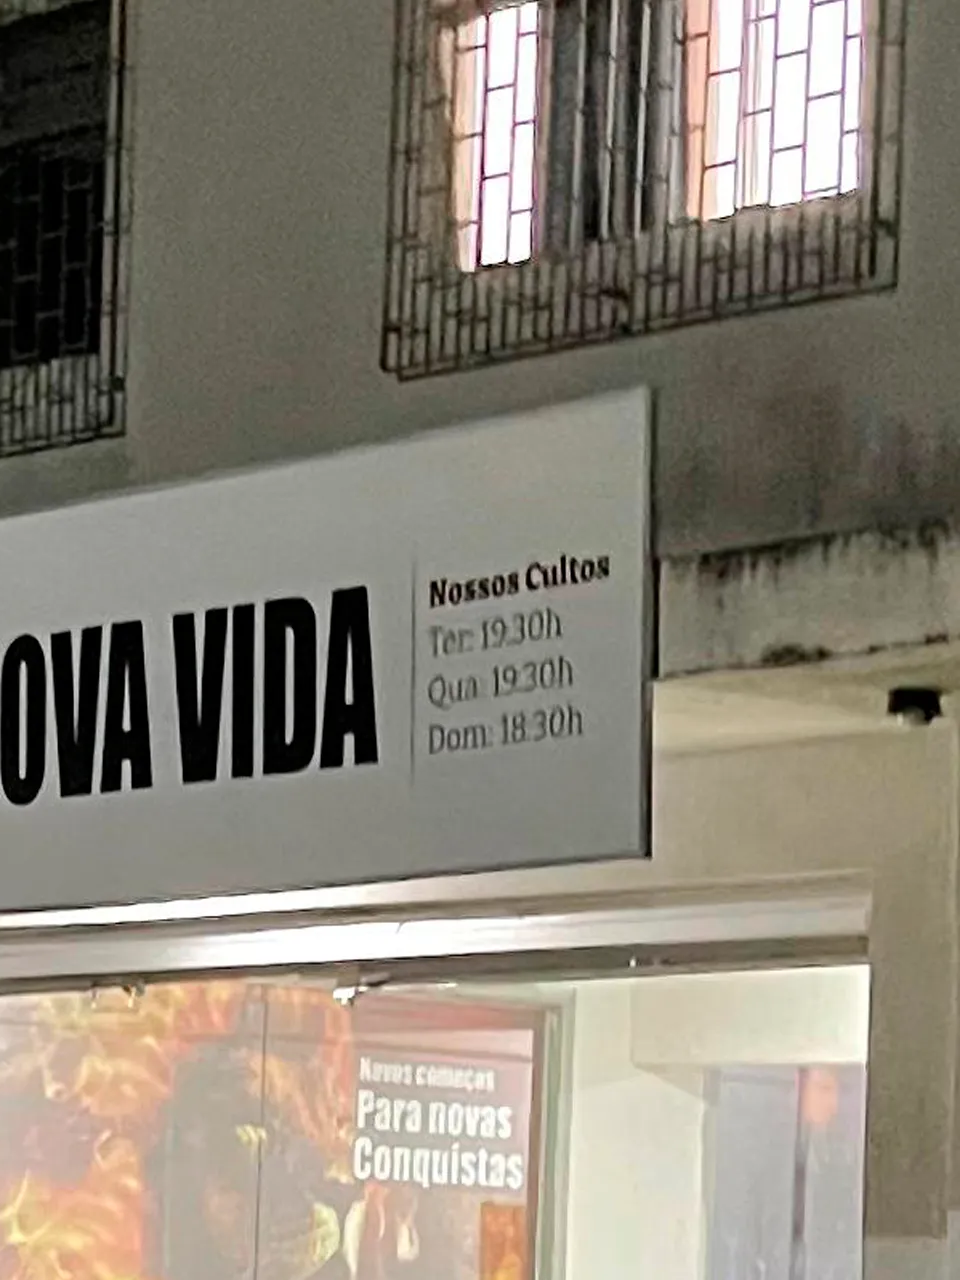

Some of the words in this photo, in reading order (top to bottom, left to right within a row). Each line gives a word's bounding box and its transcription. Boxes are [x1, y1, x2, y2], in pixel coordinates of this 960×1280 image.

[429, 573, 519, 609] Nossos
[525, 554, 610, 592] Cultos
[173, 586, 378, 784] VIDA
[356, 1089, 422, 1133] Para
[428, 1101, 513, 1139] novas
